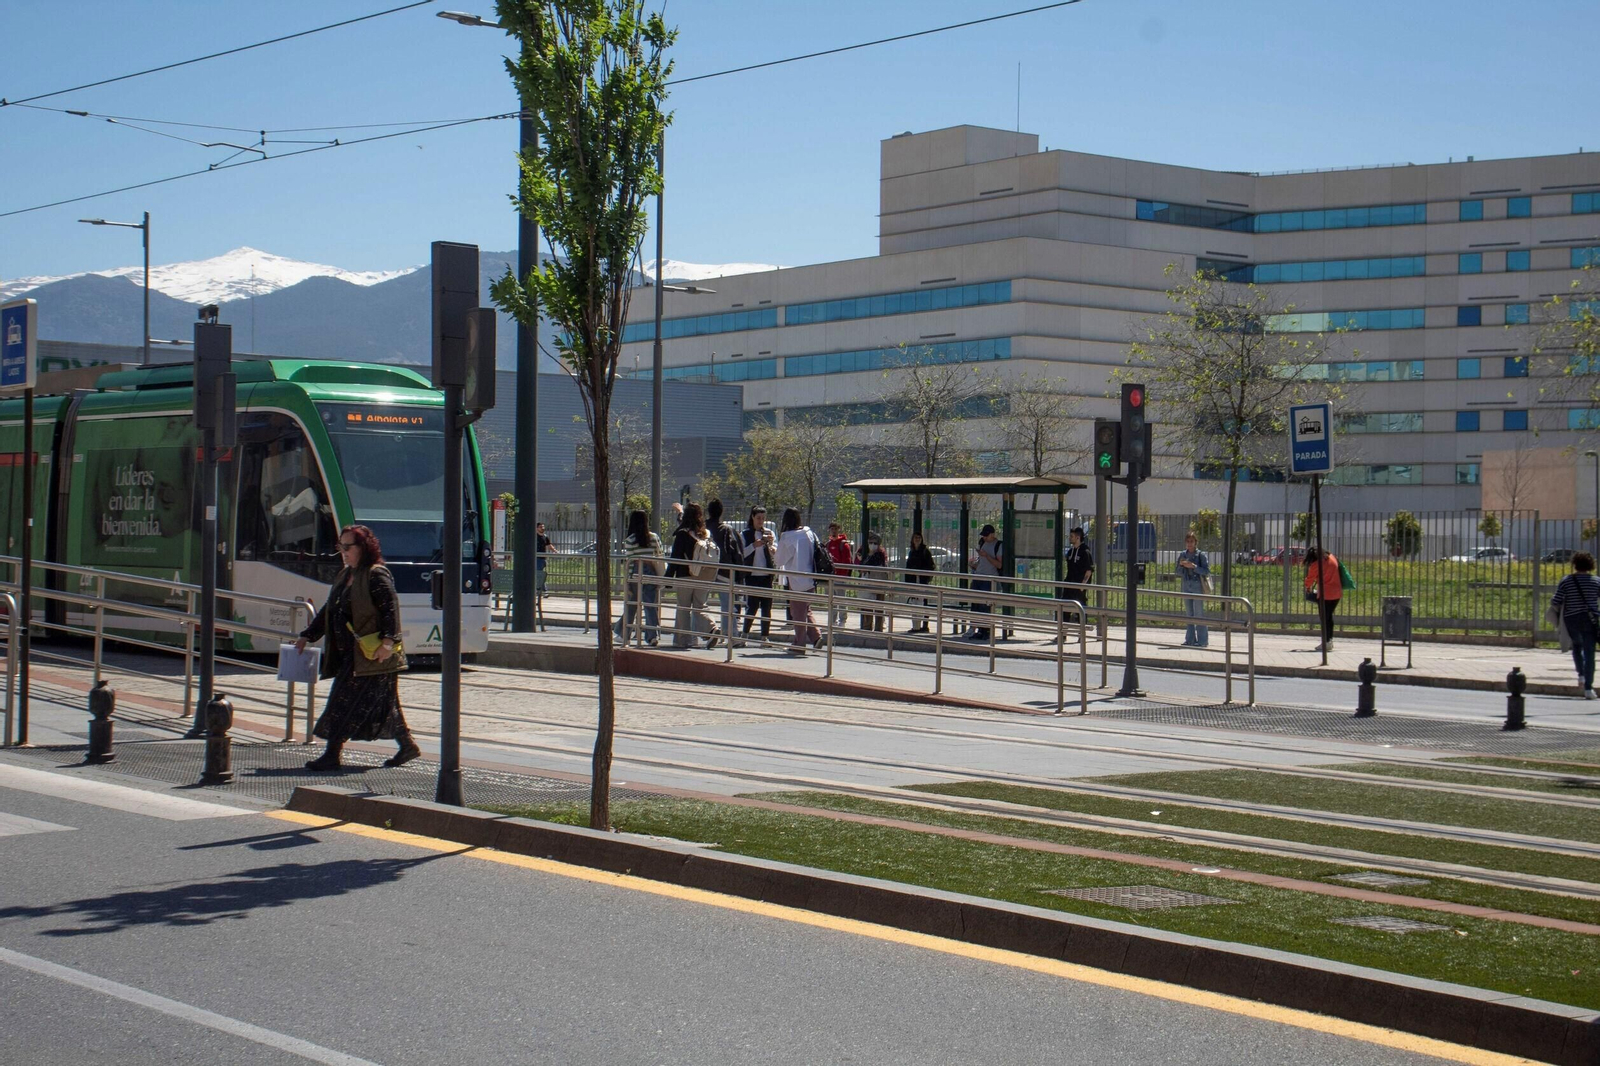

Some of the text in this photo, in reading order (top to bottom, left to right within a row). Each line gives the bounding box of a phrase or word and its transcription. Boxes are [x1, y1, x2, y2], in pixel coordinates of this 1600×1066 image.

[1295, 451, 1327, 461] PARADA
[115, 463, 154, 486] Líderes
[108, 488, 154, 510] en dar la
[102, 513, 162, 535] bienvenida.
